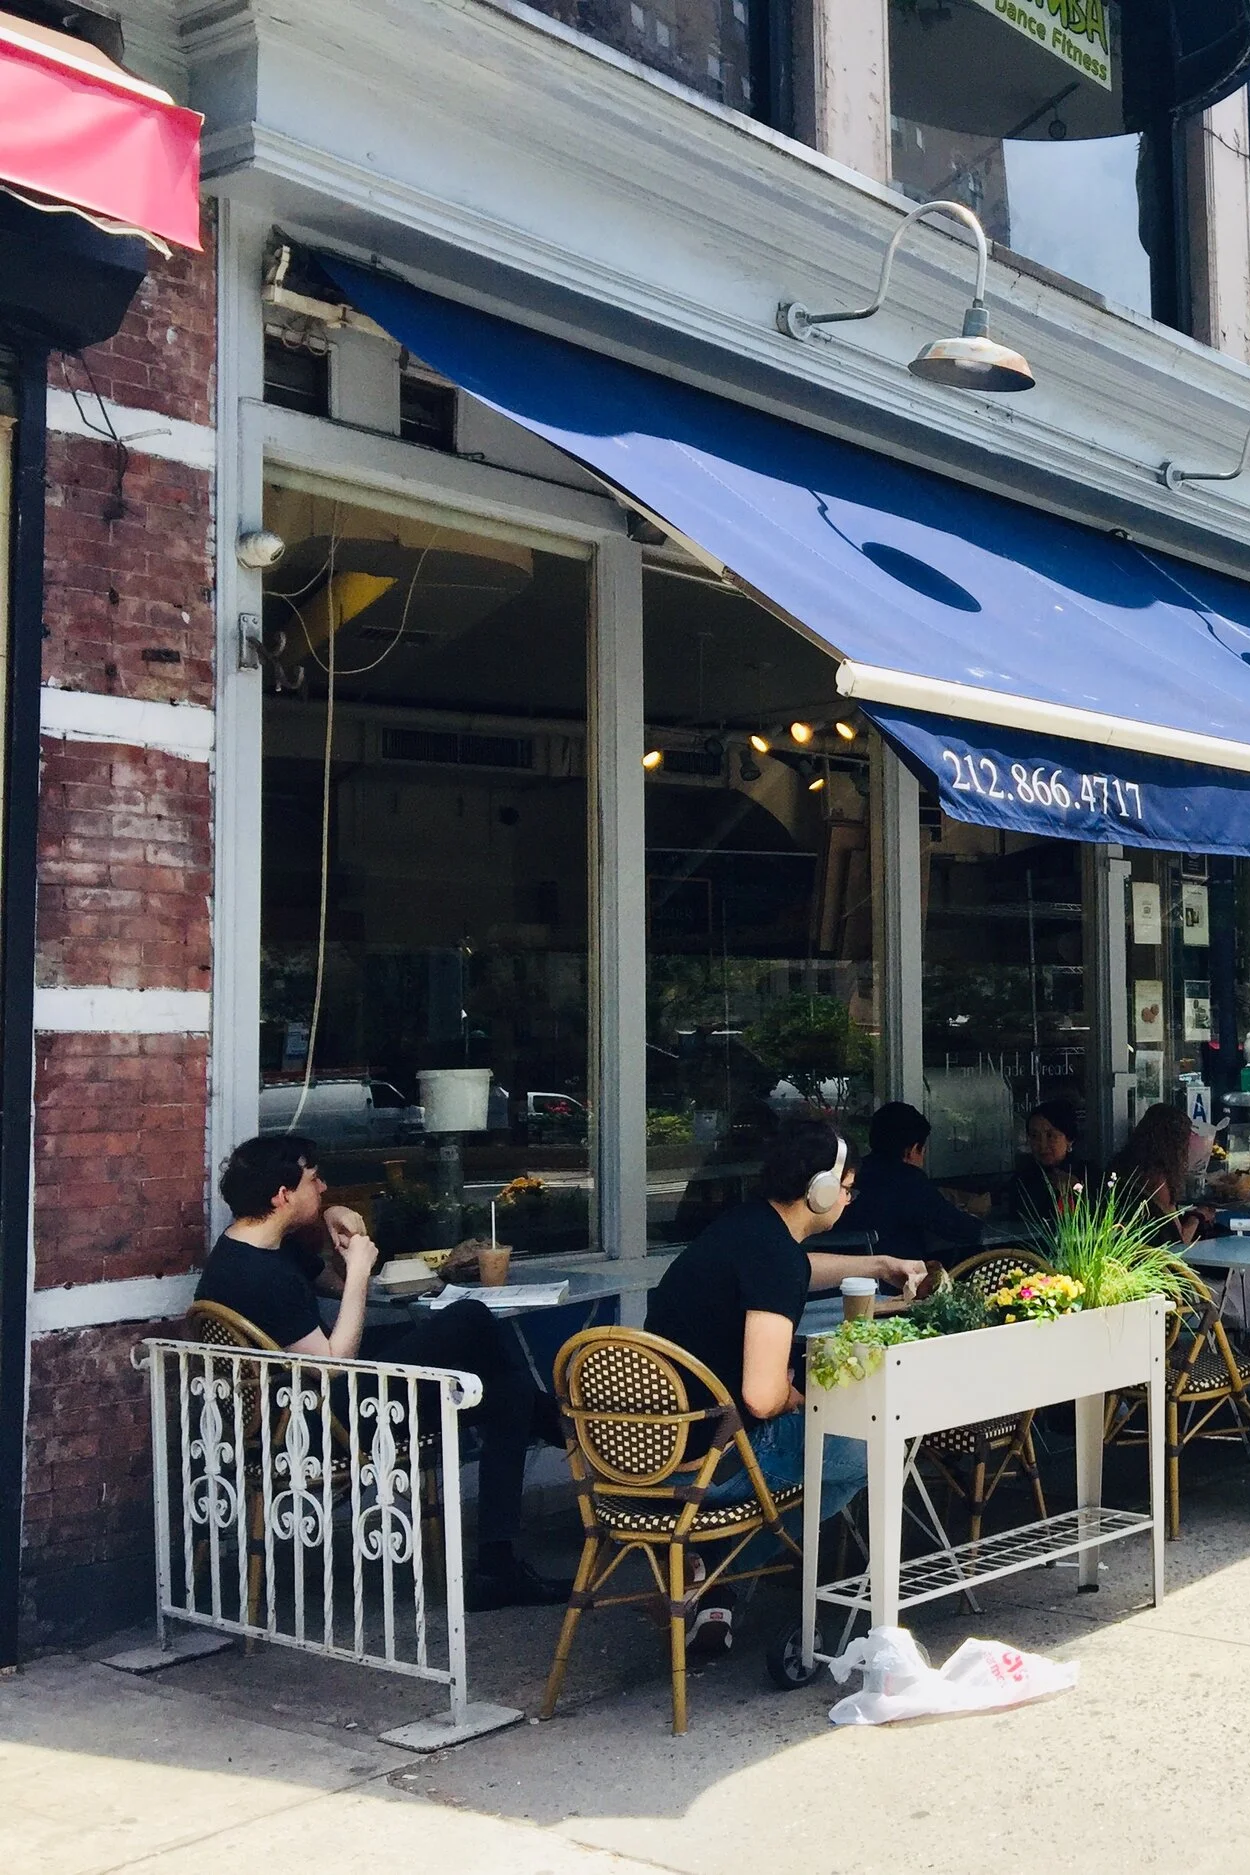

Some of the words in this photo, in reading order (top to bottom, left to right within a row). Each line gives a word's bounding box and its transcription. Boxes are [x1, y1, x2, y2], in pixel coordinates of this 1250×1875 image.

[995, 0, 1046, 41] Dance
[1052, 27, 1107, 81] Fitness
[943, 751, 1142, 819] 212.866.4717
